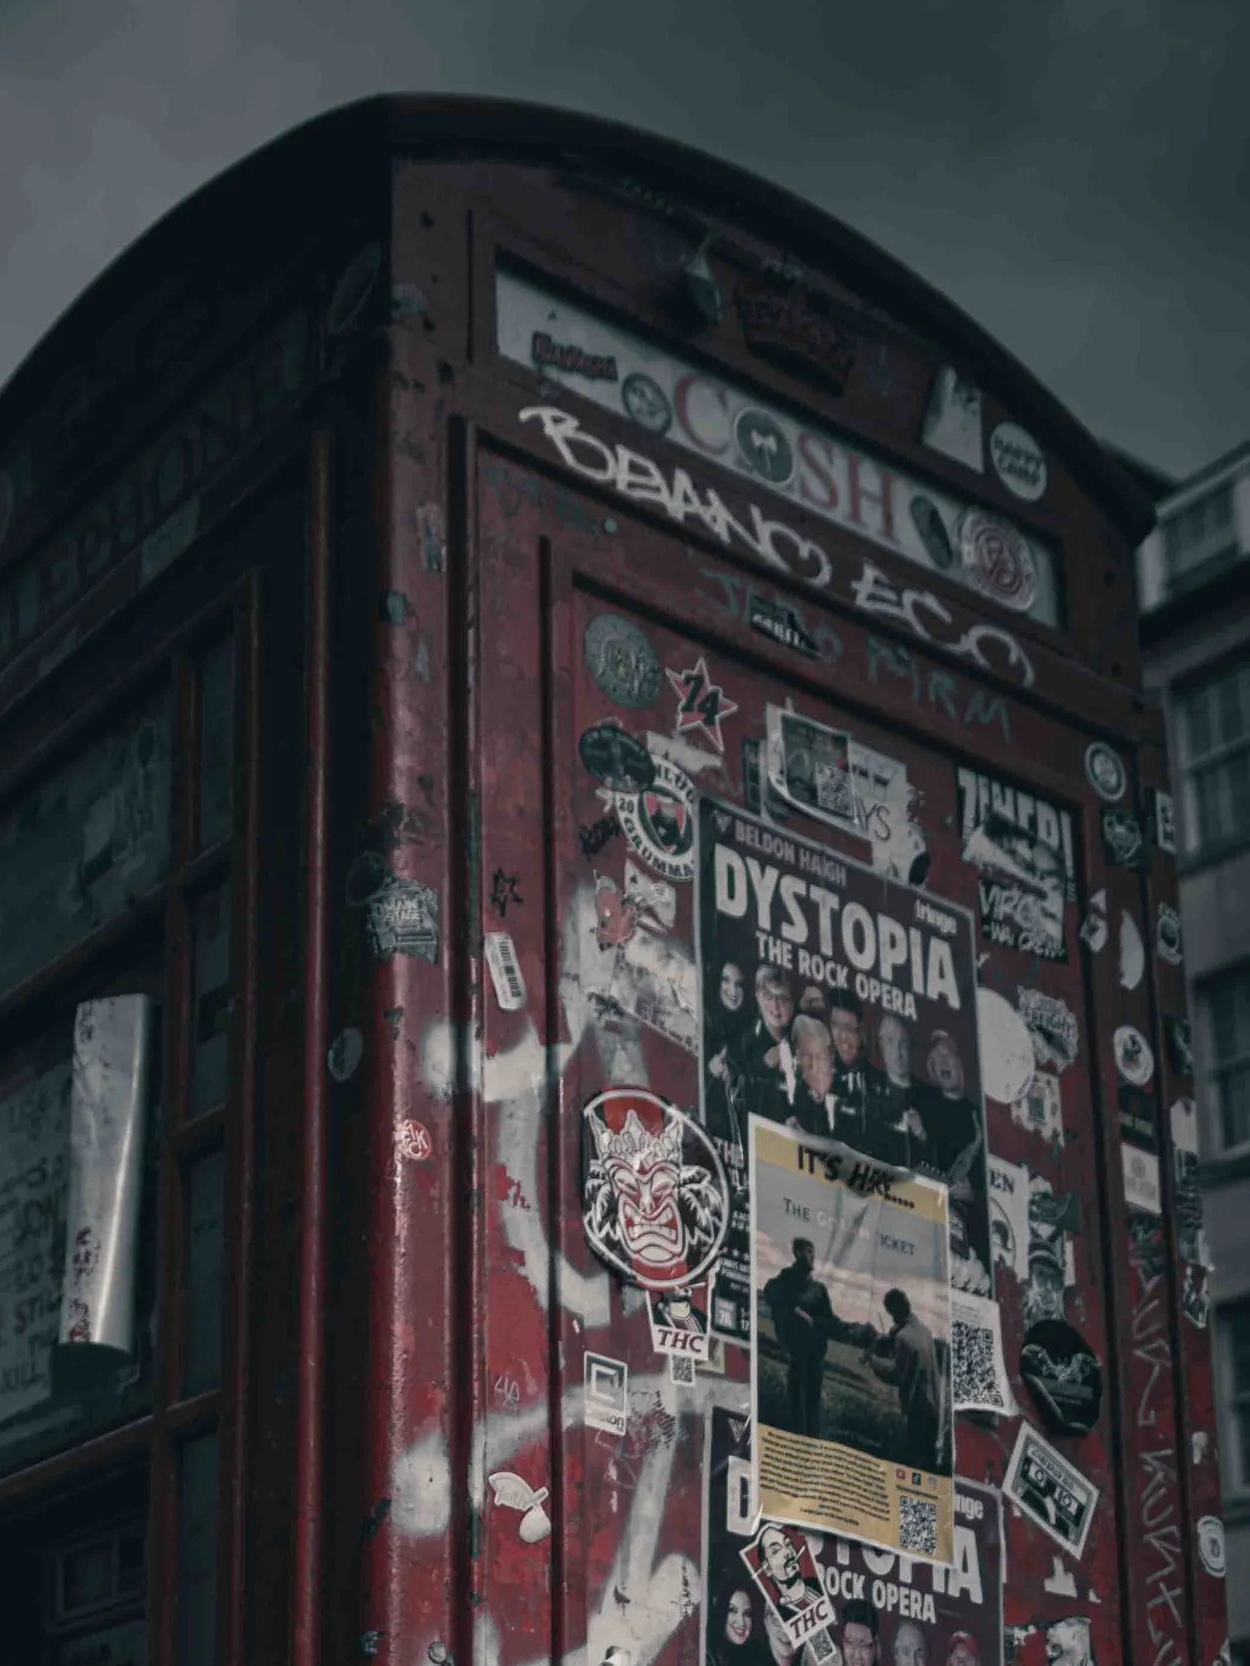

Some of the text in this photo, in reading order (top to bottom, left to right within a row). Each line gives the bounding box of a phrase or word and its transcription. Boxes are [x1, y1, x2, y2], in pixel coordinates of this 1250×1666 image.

[675, 374, 895, 540] CSH
[683, 674, 721, 726] 74
[734, 817, 847, 887] BELDON HAIGH
[714, 842, 961, 1011] DYSTOPIA
[755, 929, 917, 1022] THE ROCK OPERA
[783, 1197, 811, 1221] THE
[658, 1328, 705, 1353] THC
[790, 1602, 829, 1638] THC
[872, 1579, 938, 1624] OPERA
